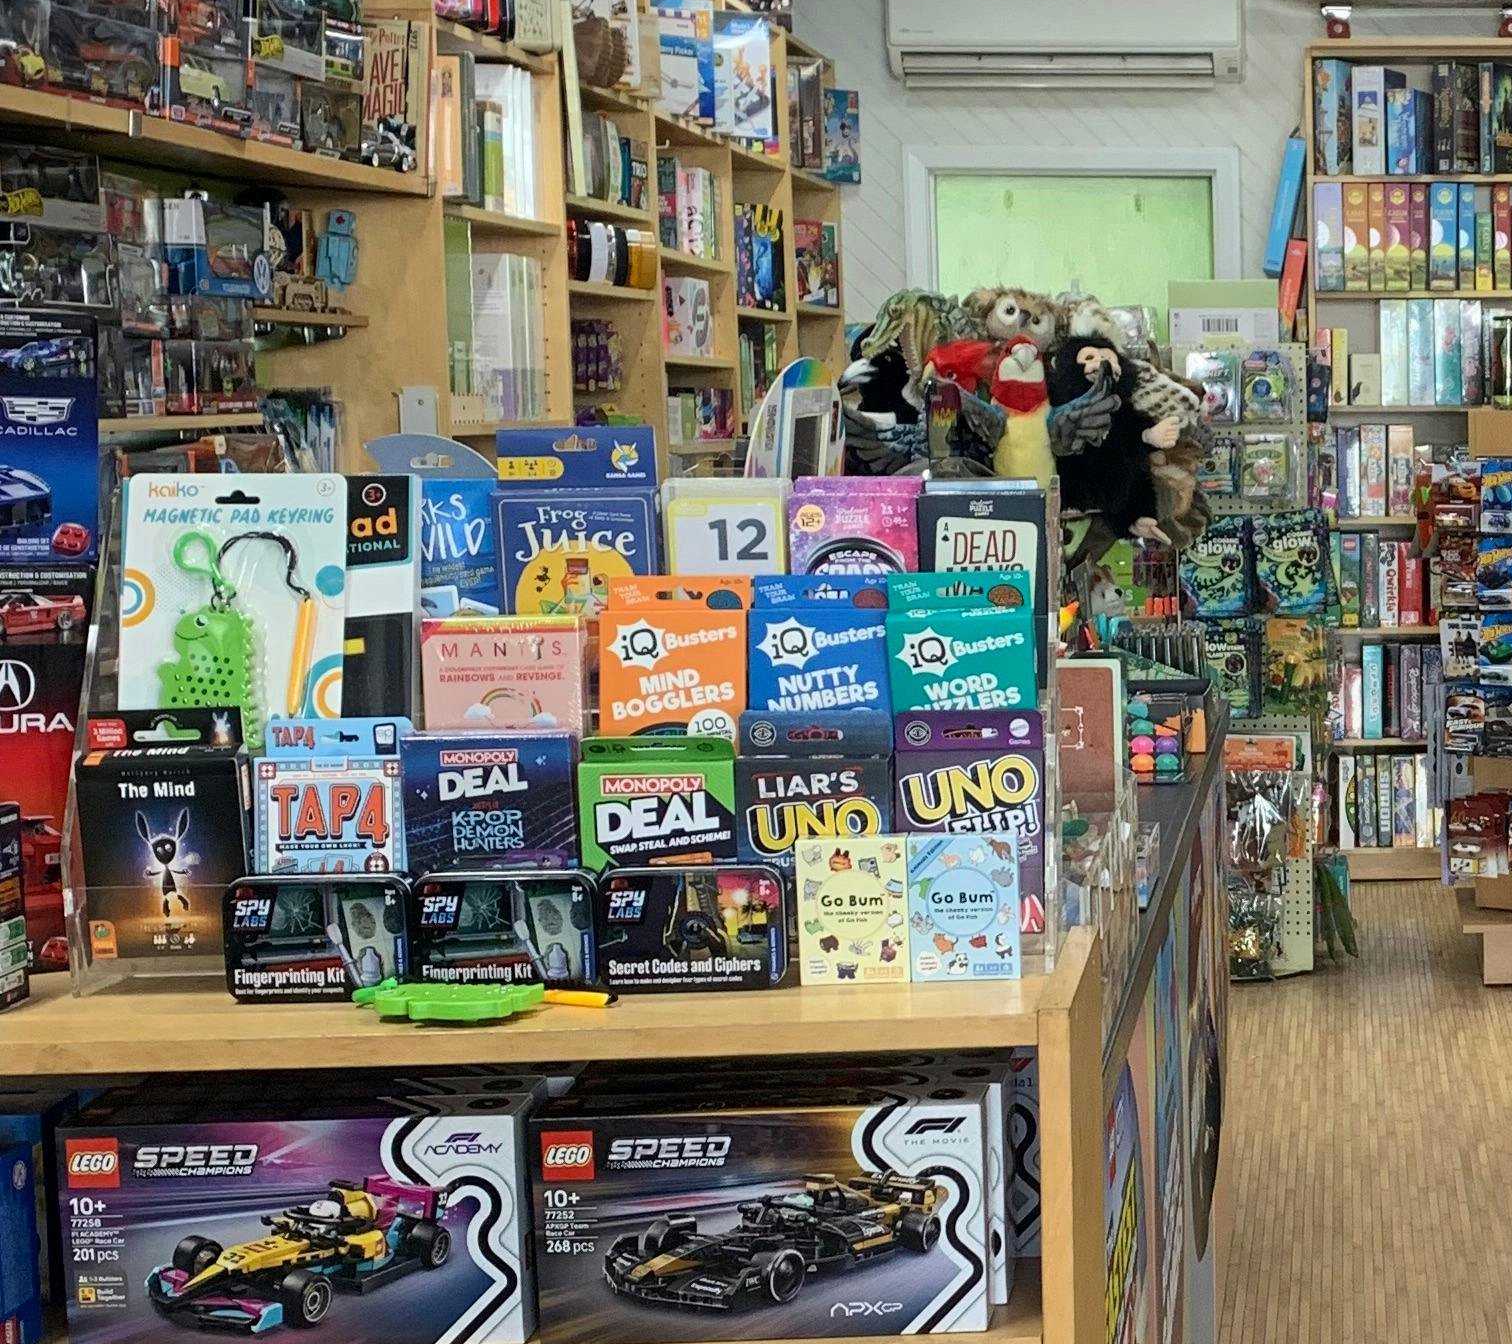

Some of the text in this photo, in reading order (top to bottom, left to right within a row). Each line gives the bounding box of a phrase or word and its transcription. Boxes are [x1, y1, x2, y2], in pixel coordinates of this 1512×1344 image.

[148, 482, 199, 498] kaiko
[143, 507, 334, 524] MAGNETIC PAD KEYRING
[537, 507, 588, 530] Frog
[516, 522, 636, 563] Juice
[708, 519, 769, 561] 12
[953, 529, 1017, 565] DEAD
[1197, 541, 1237, 557] glow
[1272, 535, 1311, 553] glow
[829, 550, 876, 560] ESCAPE
[622, 626, 737, 661] iQ Busters
[772, 624, 885, 660] iQ Busters
[639, 668, 700, 695] MIND
[778, 664, 859, 695] NUTTY
[923, 672, 998, 702] WORD
[611, 683, 735, 721] BOGGLERS
[767, 681, 879, 712] NUMBERS
[272, 726, 316, 749] TAP4
[443, 751, 515, 764] MONOPOLY
[118, 781, 195, 800] The Mind
[439, 764, 528, 801] DEAL
[603, 778, 701, 794] MONOPOLY
[757, 770, 859, 799] LIAR'S
[900, 754, 1039, 828] UNO
[270, 783, 390, 847] TAP4
[596, 791, 720, 843] DEAL
[452, 825, 523, 839] DEMON
[747, 797, 881, 856] UNO
[453, 838, 525, 851] HUNTERS
[233, 899, 271, 916] SPY
[821, 895, 883, 908] Go Bum
[931, 892, 994, 905] Go Bum
[233, 914, 267, 927] LABS
[421, 911, 455, 924] LABS
[608, 905, 642, 919] LABS
[608, 957, 761, 975] Secret Codes and Ciphers
[234, 968, 345, 986] Fingerprinting Kit
[424, 1143, 503, 1155] ACADEMY
[903, 1137, 970, 1147] THE MOVIE
[69, 1144, 258, 1174] LEGO SPEED
[544, 1136, 732, 1167] LEGO SPEED
[179, 1167, 252, 1176] CHAMPIONS
[652, 1158, 725, 1168] CHAMPIONS
[69, 1197, 106, 1215] 10+
[544, 1190, 580, 1207] 10+
[545, 1211, 574, 1220] 77252
[73, 1248, 119, 1264] 201 pcs
[547, 1241, 595, 1255] 268 pcs
